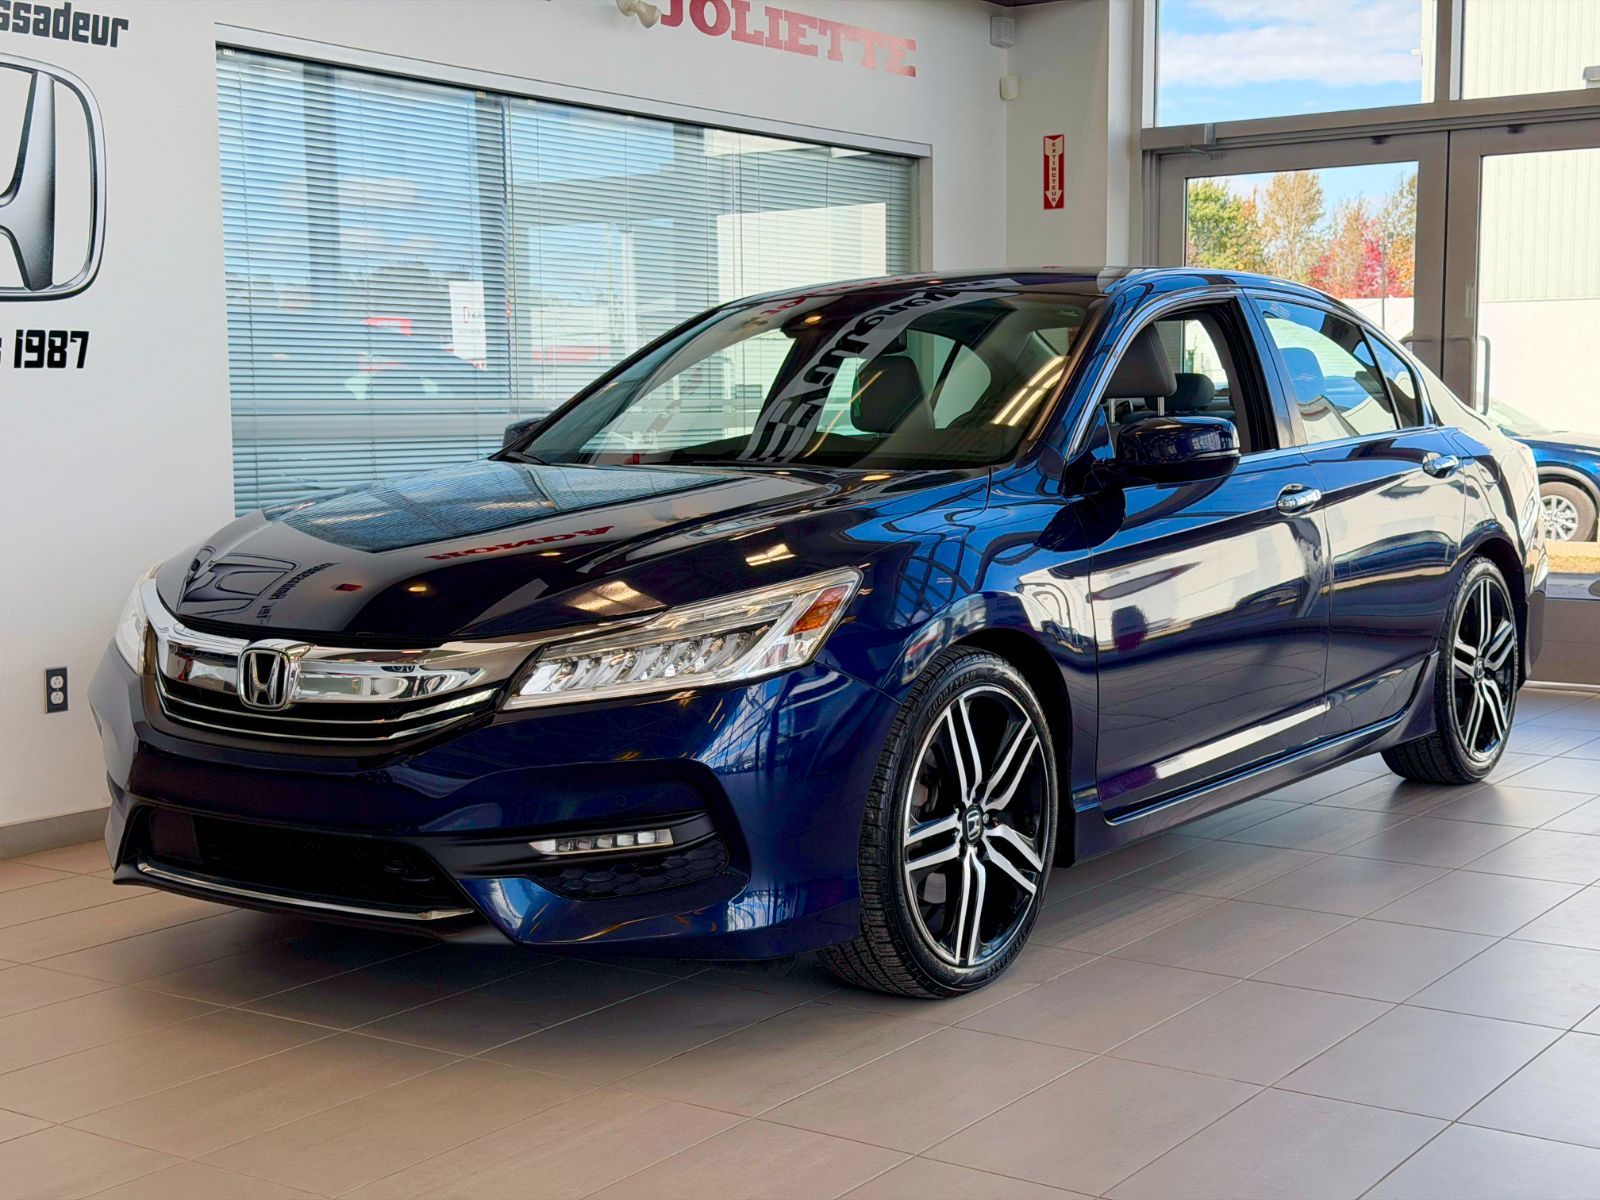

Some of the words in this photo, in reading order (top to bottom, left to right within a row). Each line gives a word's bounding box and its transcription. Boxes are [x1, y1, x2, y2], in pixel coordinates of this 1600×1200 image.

[661, 0, 916, 78] JOLIETTE
[14, 329, 89, 368] 1987
[928, 671, 977, 719] GOODYEAR
